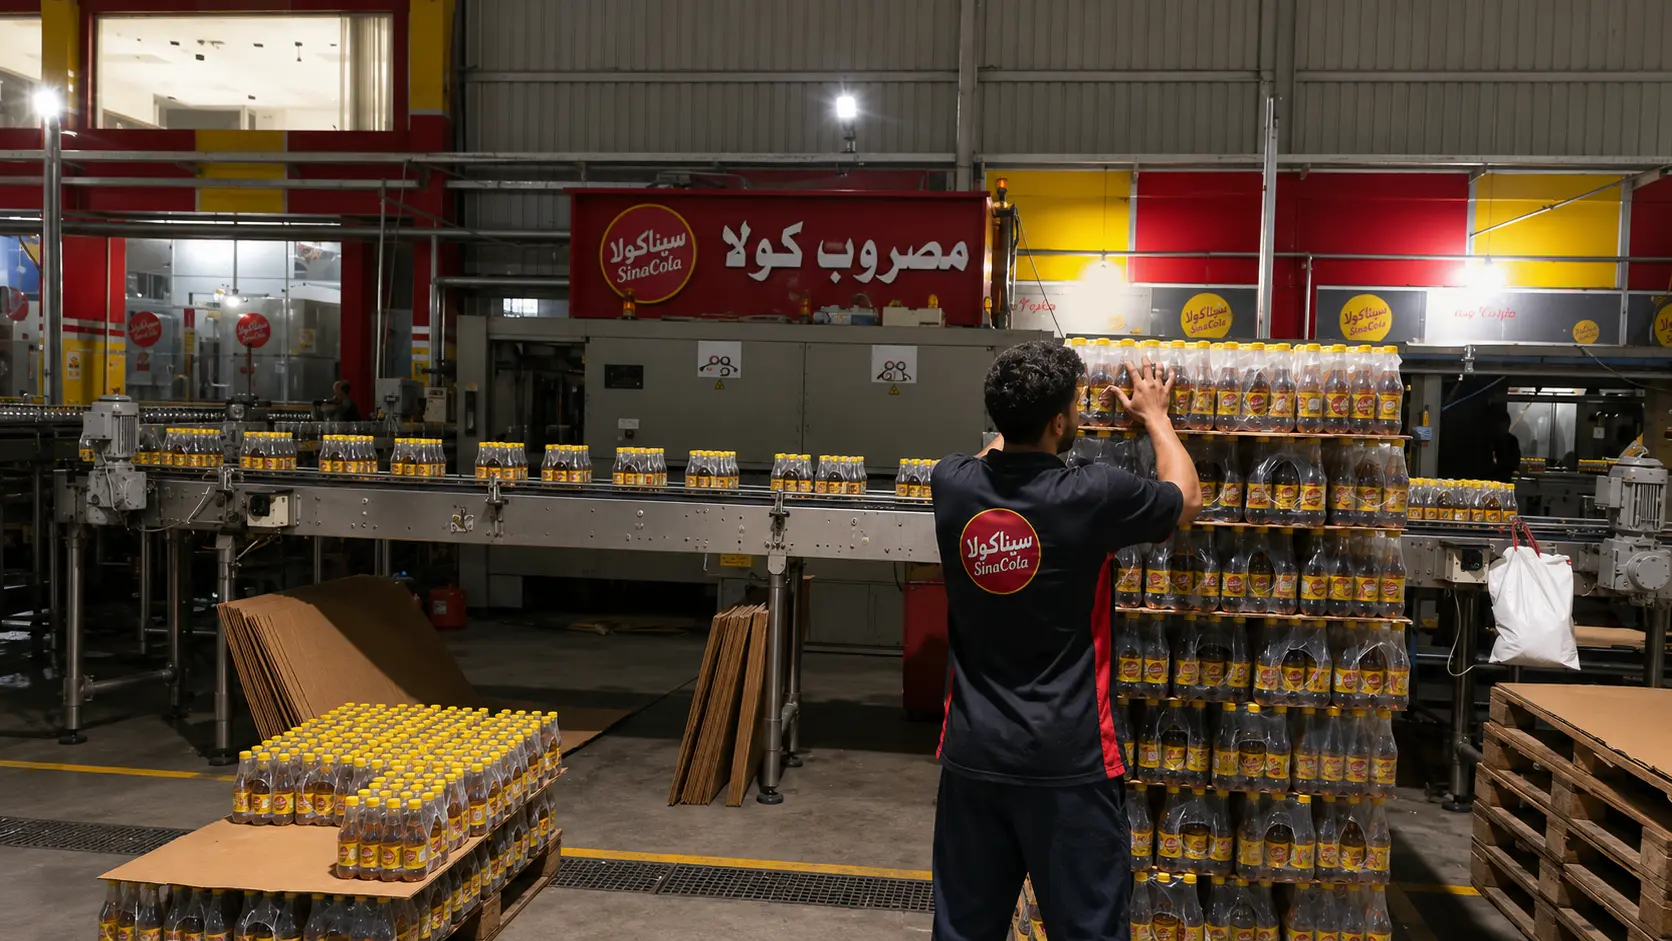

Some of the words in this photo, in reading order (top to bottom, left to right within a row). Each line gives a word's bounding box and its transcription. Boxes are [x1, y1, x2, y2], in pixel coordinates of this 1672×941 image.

[610, 229, 686, 264] سيناكولا
[722, 220, 804, 282] كولا
[616, 255, 682, 283] SinaCola
[967, 531, 1032, 560] سيناكولا
[974, 556, 1029, 576] SinaCola
